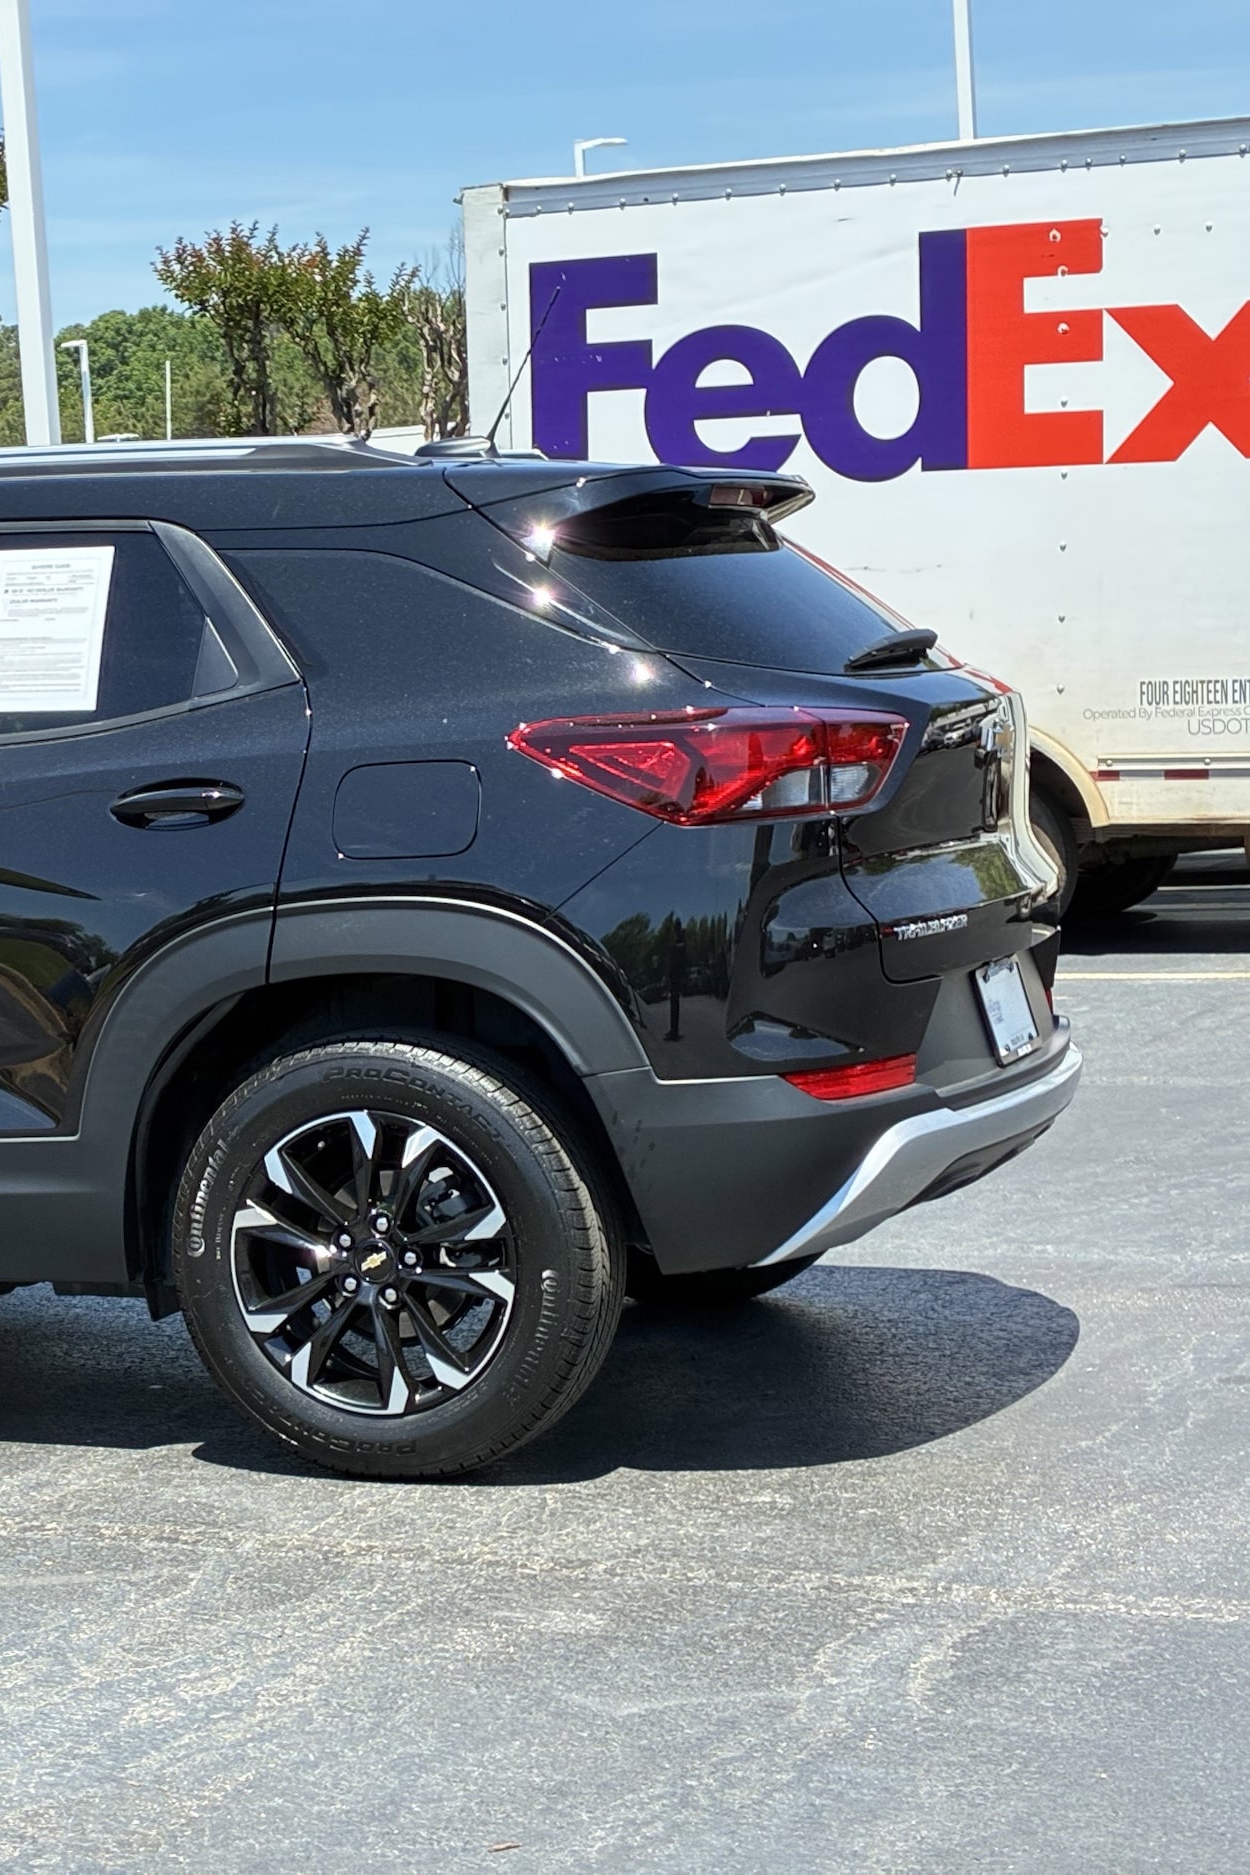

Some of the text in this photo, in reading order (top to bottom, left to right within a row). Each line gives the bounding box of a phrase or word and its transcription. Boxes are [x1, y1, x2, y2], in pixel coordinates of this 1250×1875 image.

[529, 218, 1250, 482] FedEx
[1139, 680, 1169, 706] FOUR
[1172, 679, 1228, 705] EIGHTEEN
[1083, 707, 1136, 721] Operated
[1138, 707, 1153, 721] By
[1155, 706, 1196, 719] Federal
[1198, 705, 1242, 719] Express
[1187, 718, 1250, 736] USDOT
[187, 1138, 229, 1258] Continental
